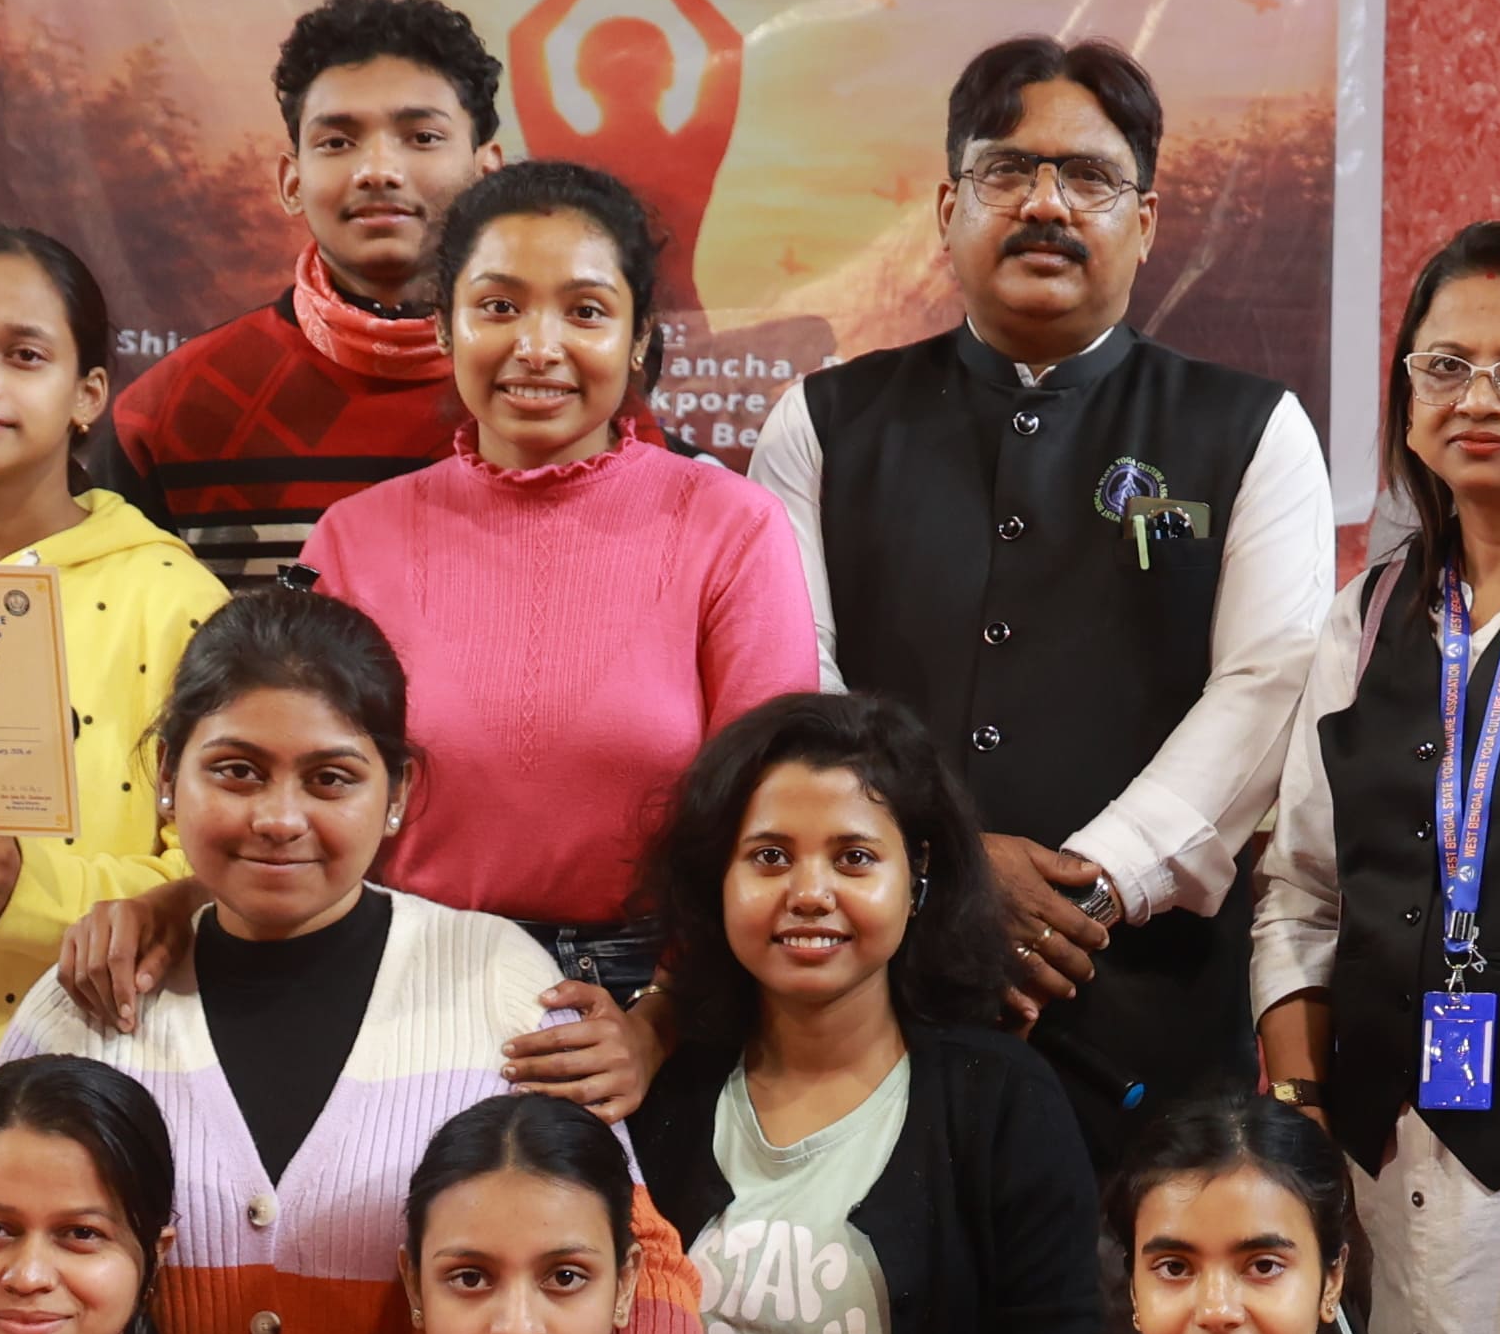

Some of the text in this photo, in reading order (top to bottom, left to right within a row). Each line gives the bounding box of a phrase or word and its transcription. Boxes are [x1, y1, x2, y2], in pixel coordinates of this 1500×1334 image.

[1479, 734, 1494, 765] YOGA
[1442, 662, 1461, 879] WEST BENGAL STATE YOGA CULTURE ASSOCIATION
[1474, 762, 1489, 791] STATE
[1468, 789, 1484, 832] BENGAL
[1464, 831, 1478, 860] WEST
